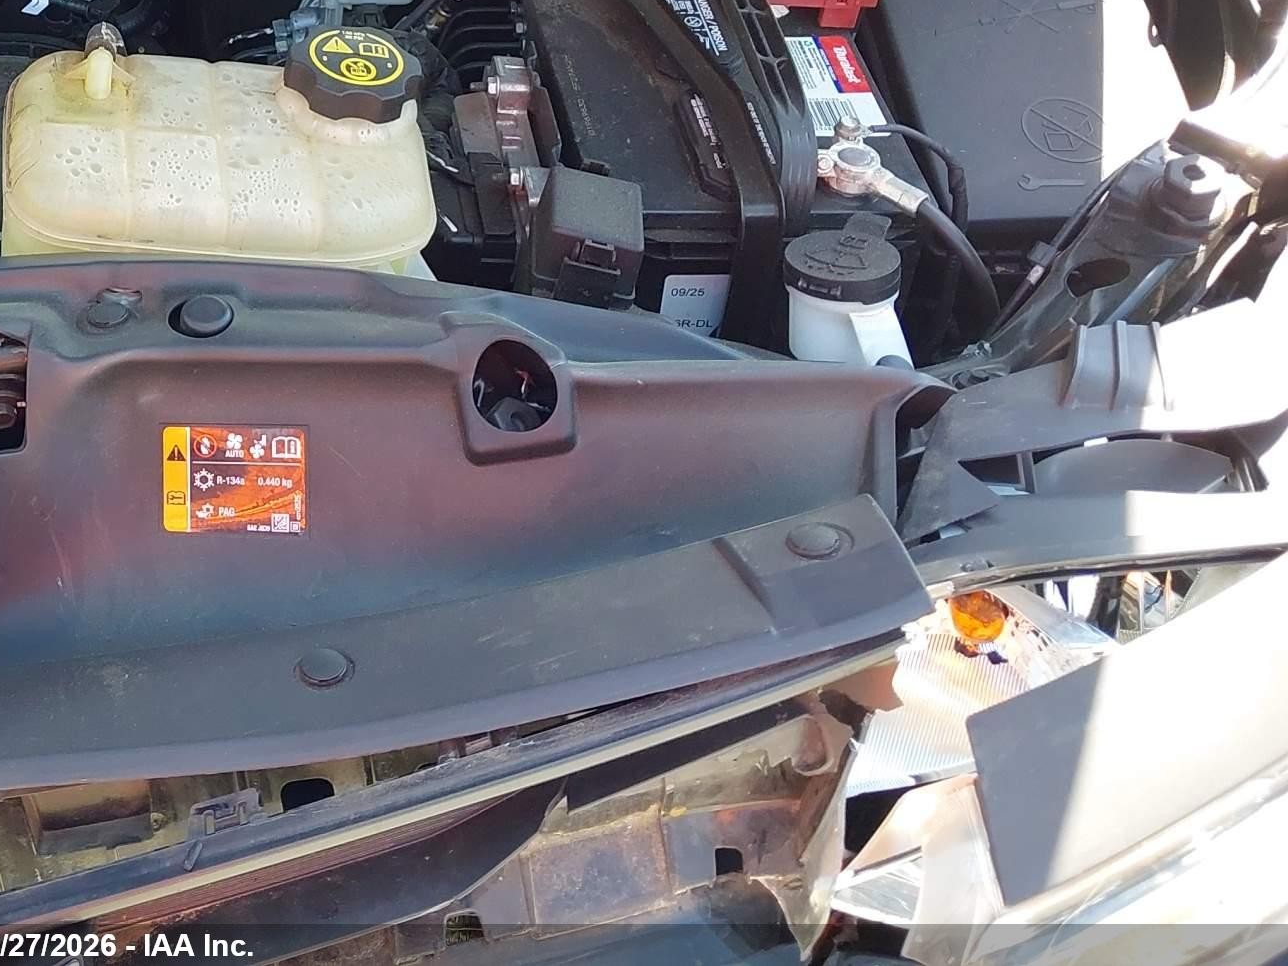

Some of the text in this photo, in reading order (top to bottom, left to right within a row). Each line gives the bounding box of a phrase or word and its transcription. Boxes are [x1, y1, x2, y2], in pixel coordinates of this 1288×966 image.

[707, 25, 729, 52] POISON
[832, 44, 862, 84] Duralast
[671, 287, 705, 297] 09/25
[225, 448, 245, 458] AUTO
[216, 476, 293, 489] R-134a 0.440 kg
